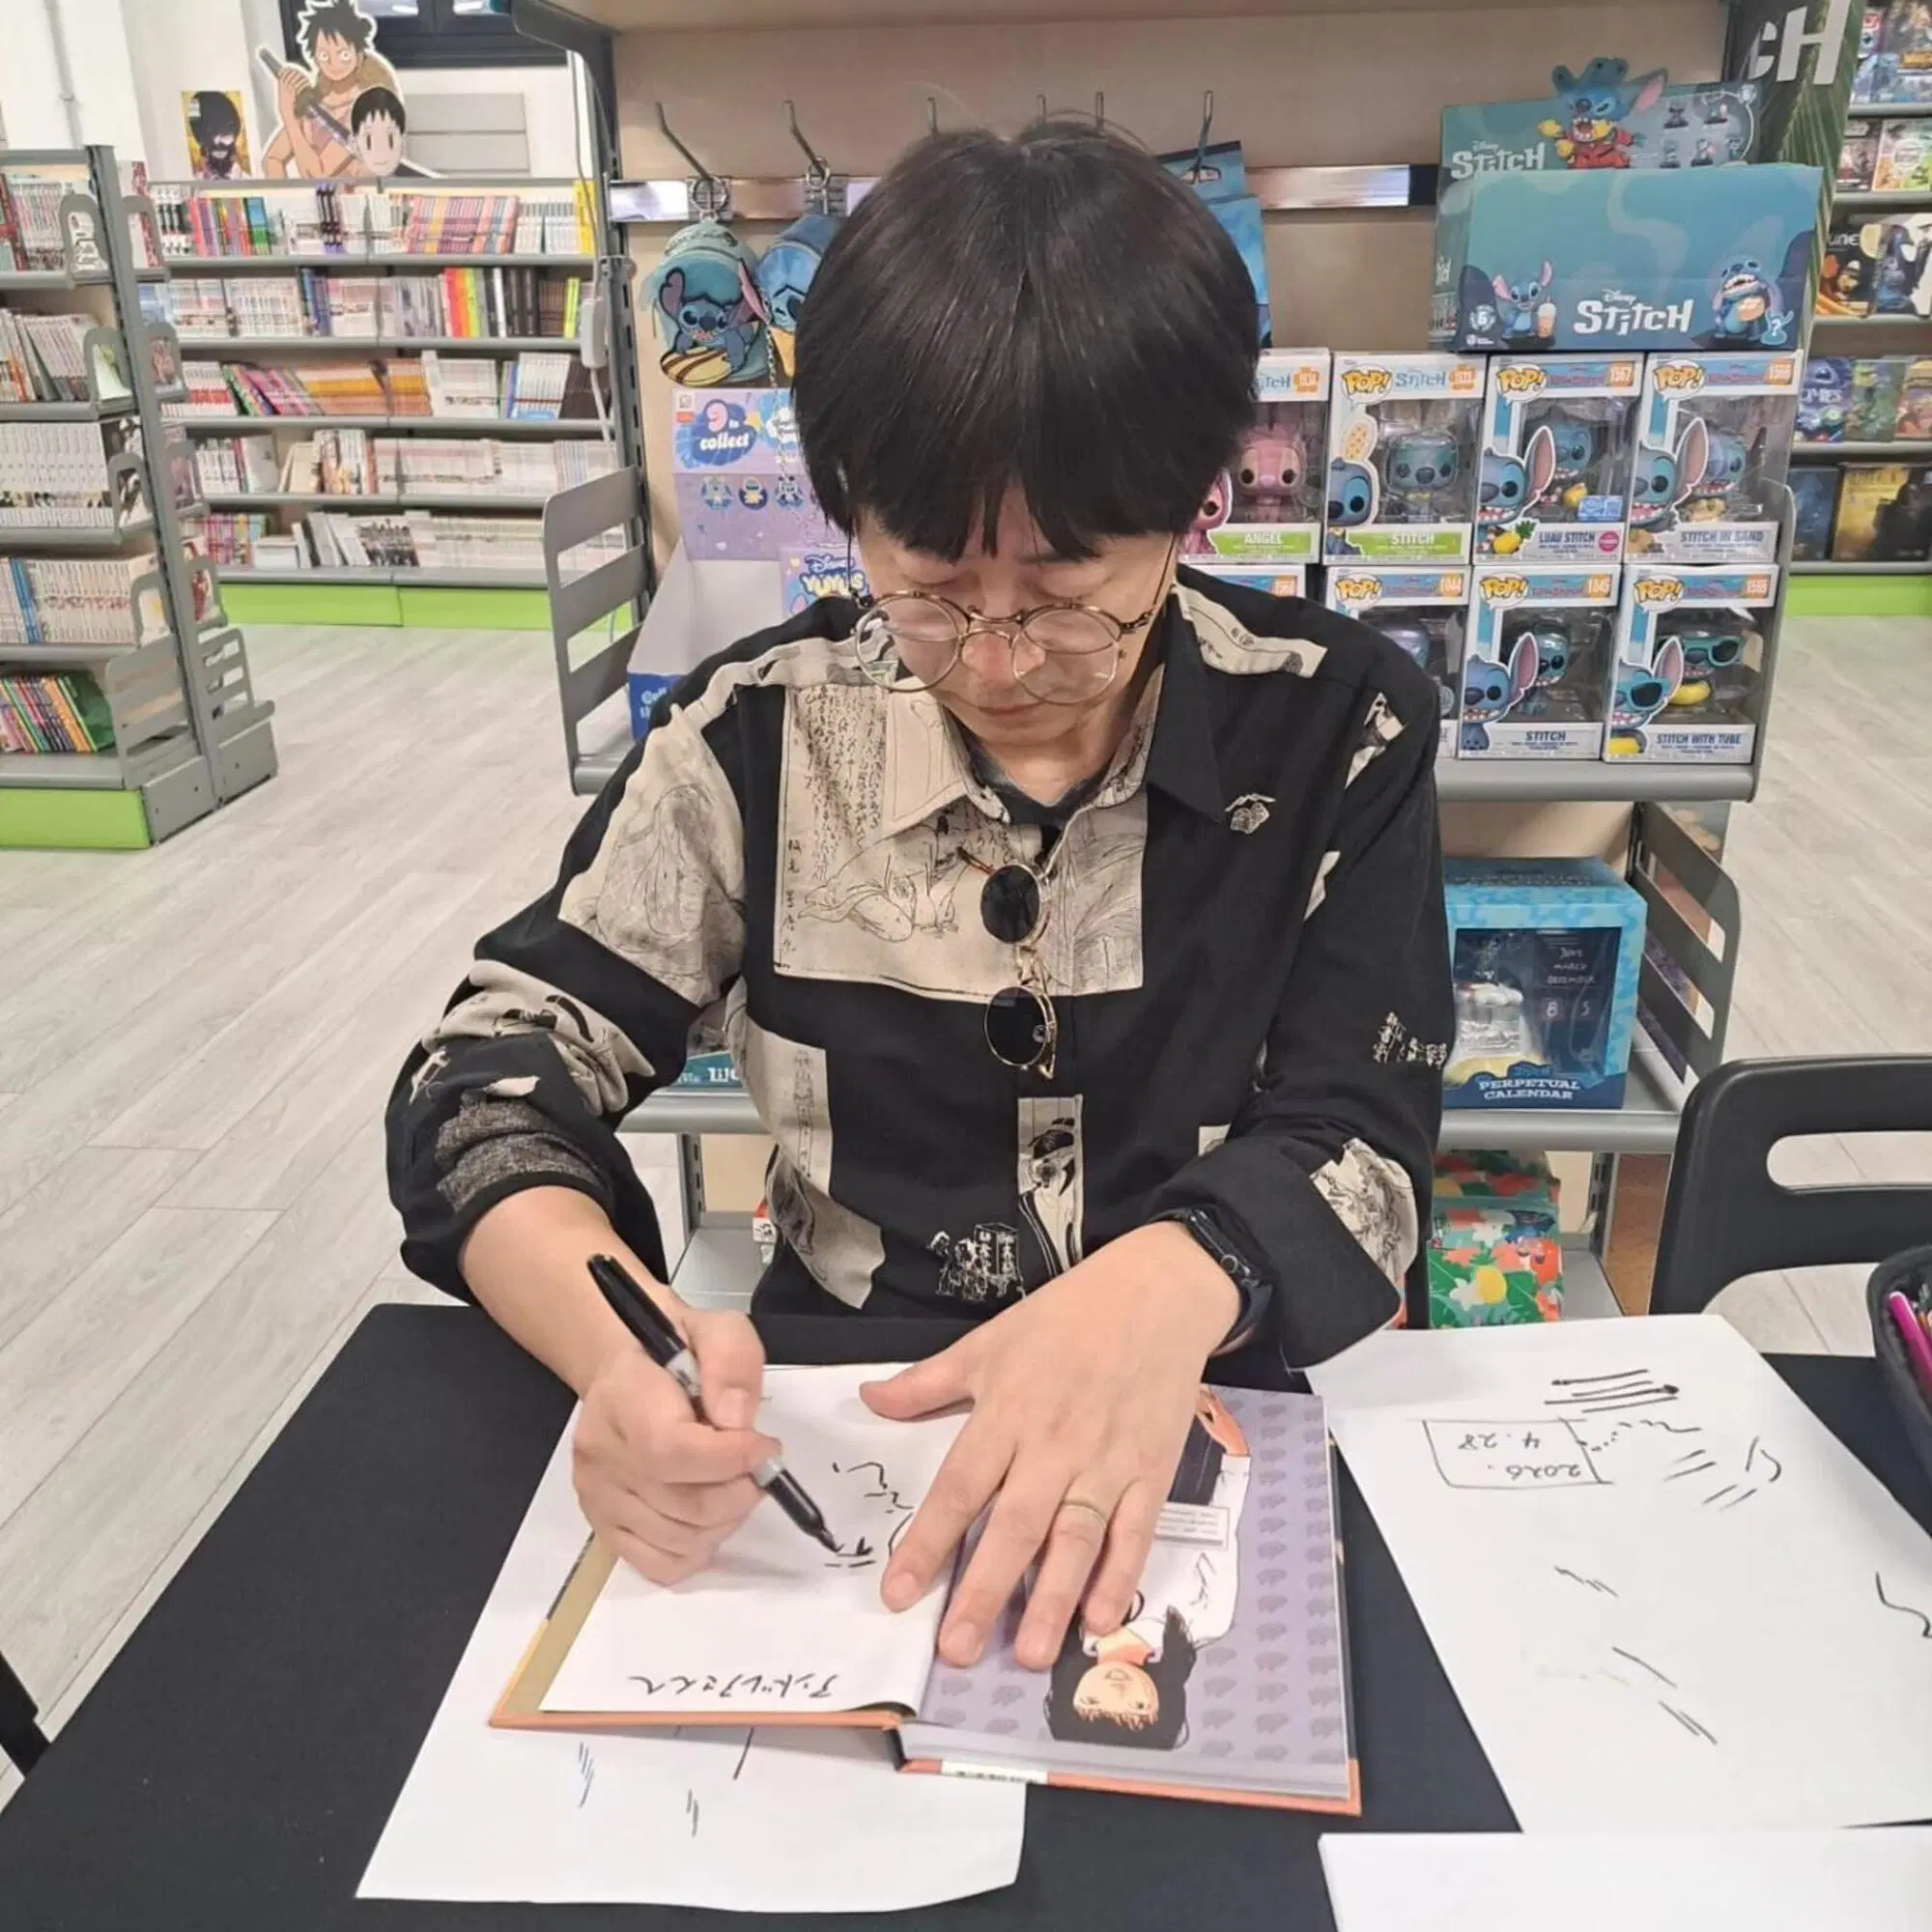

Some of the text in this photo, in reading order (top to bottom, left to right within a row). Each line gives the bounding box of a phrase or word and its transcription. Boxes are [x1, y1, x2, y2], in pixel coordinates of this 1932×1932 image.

[1342, 369, 1392, 395] POP!
[1497, 367, 1547, 393] POP!
[1654, 364, 1706, 392] POP!
[700, 433, 750, 451] collect
[1244, 531, 1283, 545] ANGEL
[1392, 531, 1435, 545] STITCH
[1563, 531, 1595, 543] STITCH
[1681, 531, 1717, 543] STITCH
[1336, 580, 1381, 601] POP!
[1480, 576, 1529, 601] POP!
[1634, 579, 1684, 603] POP!
[1525, 730, 1566, 742] STITCH
[1657, 733, 1689, 745] STITCH
[1691, 733, 1716, 744] WITH
[1478, 1078, 1581, 1092] PERPETUAL
[1484, 1089, 1574, 1100] CALENDAR
